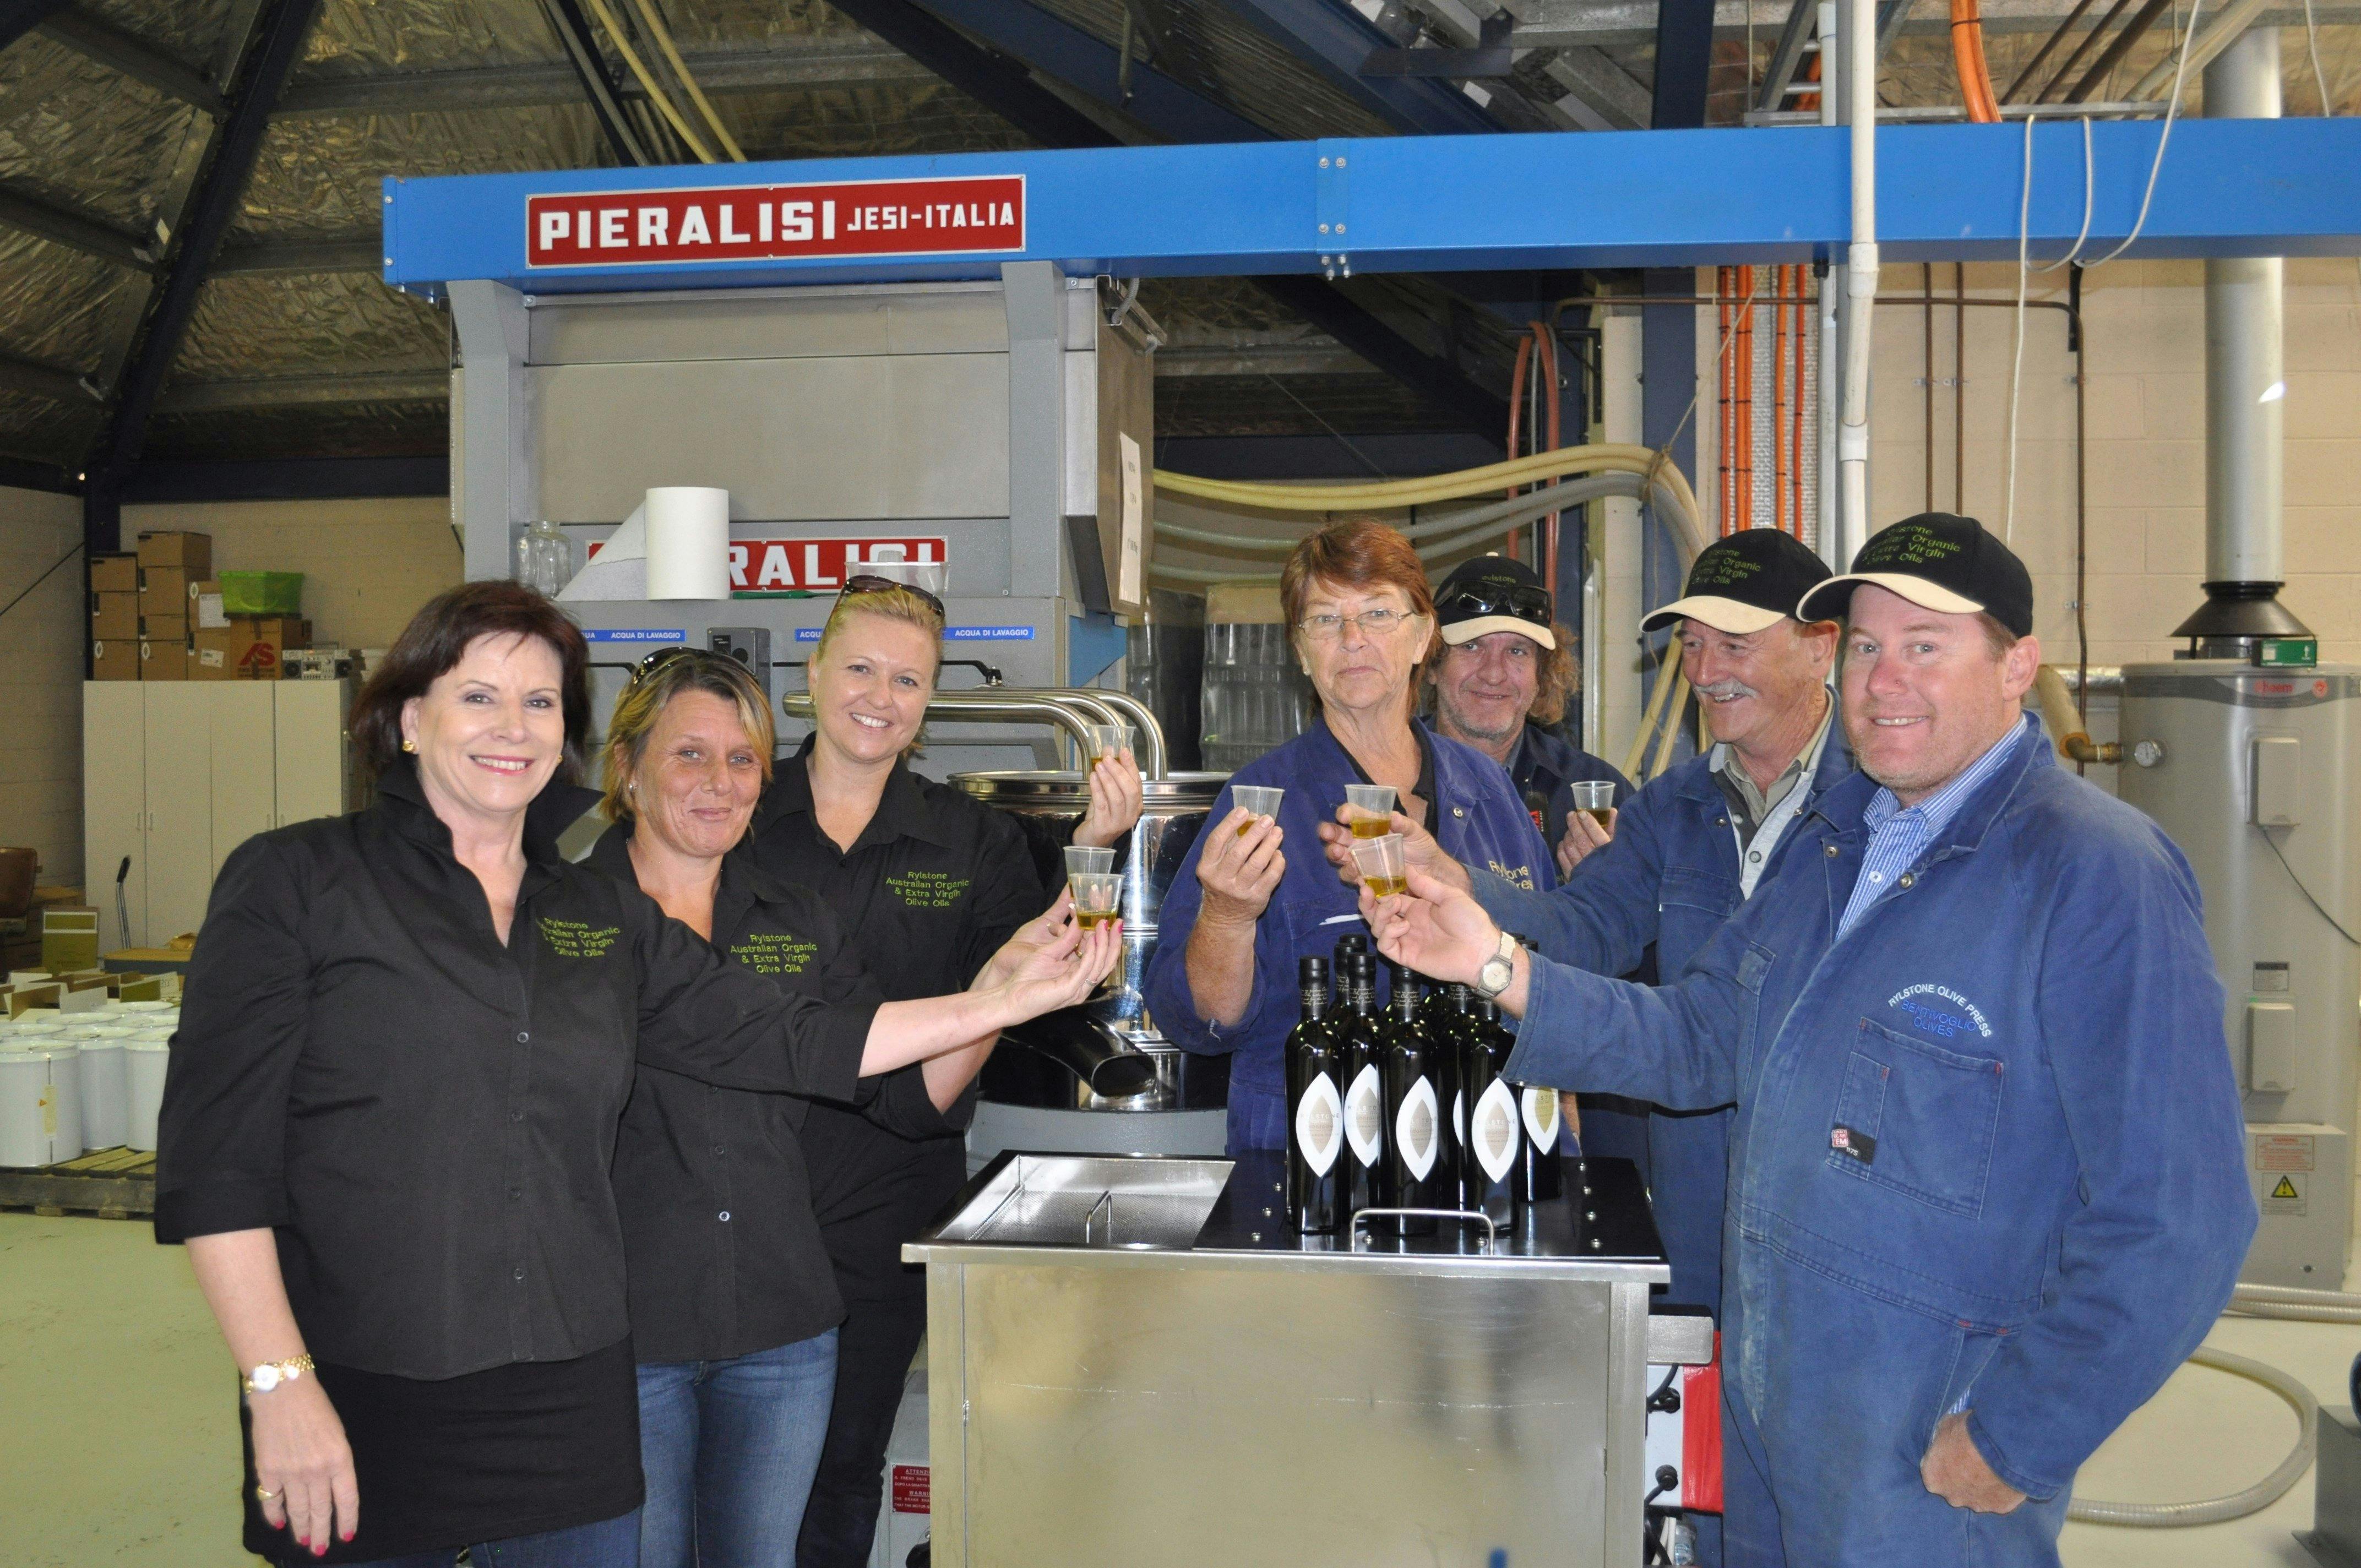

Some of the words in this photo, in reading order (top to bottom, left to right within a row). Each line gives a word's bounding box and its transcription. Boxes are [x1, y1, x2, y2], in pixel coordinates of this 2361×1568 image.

[540, 200, 836, 250] PIERALISI
[847, 202, 1015, 231] JESI-ITALIA
[1912, 534, 1960, 551] Organic
[1908, 542, 1945, 558] Virgin
[1723, 557, 1761, 571] Organic
[1899, 553, 1923, 563] Oils
[1720, 565, 1748, 579] Virgin
[908, 871, 948, 880] Rylstone
[885, 877, 931, 889] Australian
[935, 879, 969, 890] Organic
[906, 889, 930, 897] Extra
[935, 889, 961, 899] Virgin
[905, 898, 928, 906] Olive
[578, 927, 621, 939] Organic
[750, 934, 792, 944] Rylstone
[580, 938, 614, 948] Virgin
[730, 944, 777, 954] Australian
[782, 942, 817, 953] Organic
[584, 949, 605, 957] Oils
[742, 955, 749, 963] &
[753, 954, 780, 963] Extra
[784, 953, 810, 963] Virgin
[756, 965, 780, 973] Olive
[785, 964, 802, 972] Oils
[1888, 983, 1935, 1007] RYLSTONE
[1937, 986, 1967, 1006] OLIVE
[1965, 1004, 1992, 1038] PRESS
[1901, 1000, 1976, 1031] BENTIVOGLIO
[1913, 1017, 1953, 1037] OLIVES
